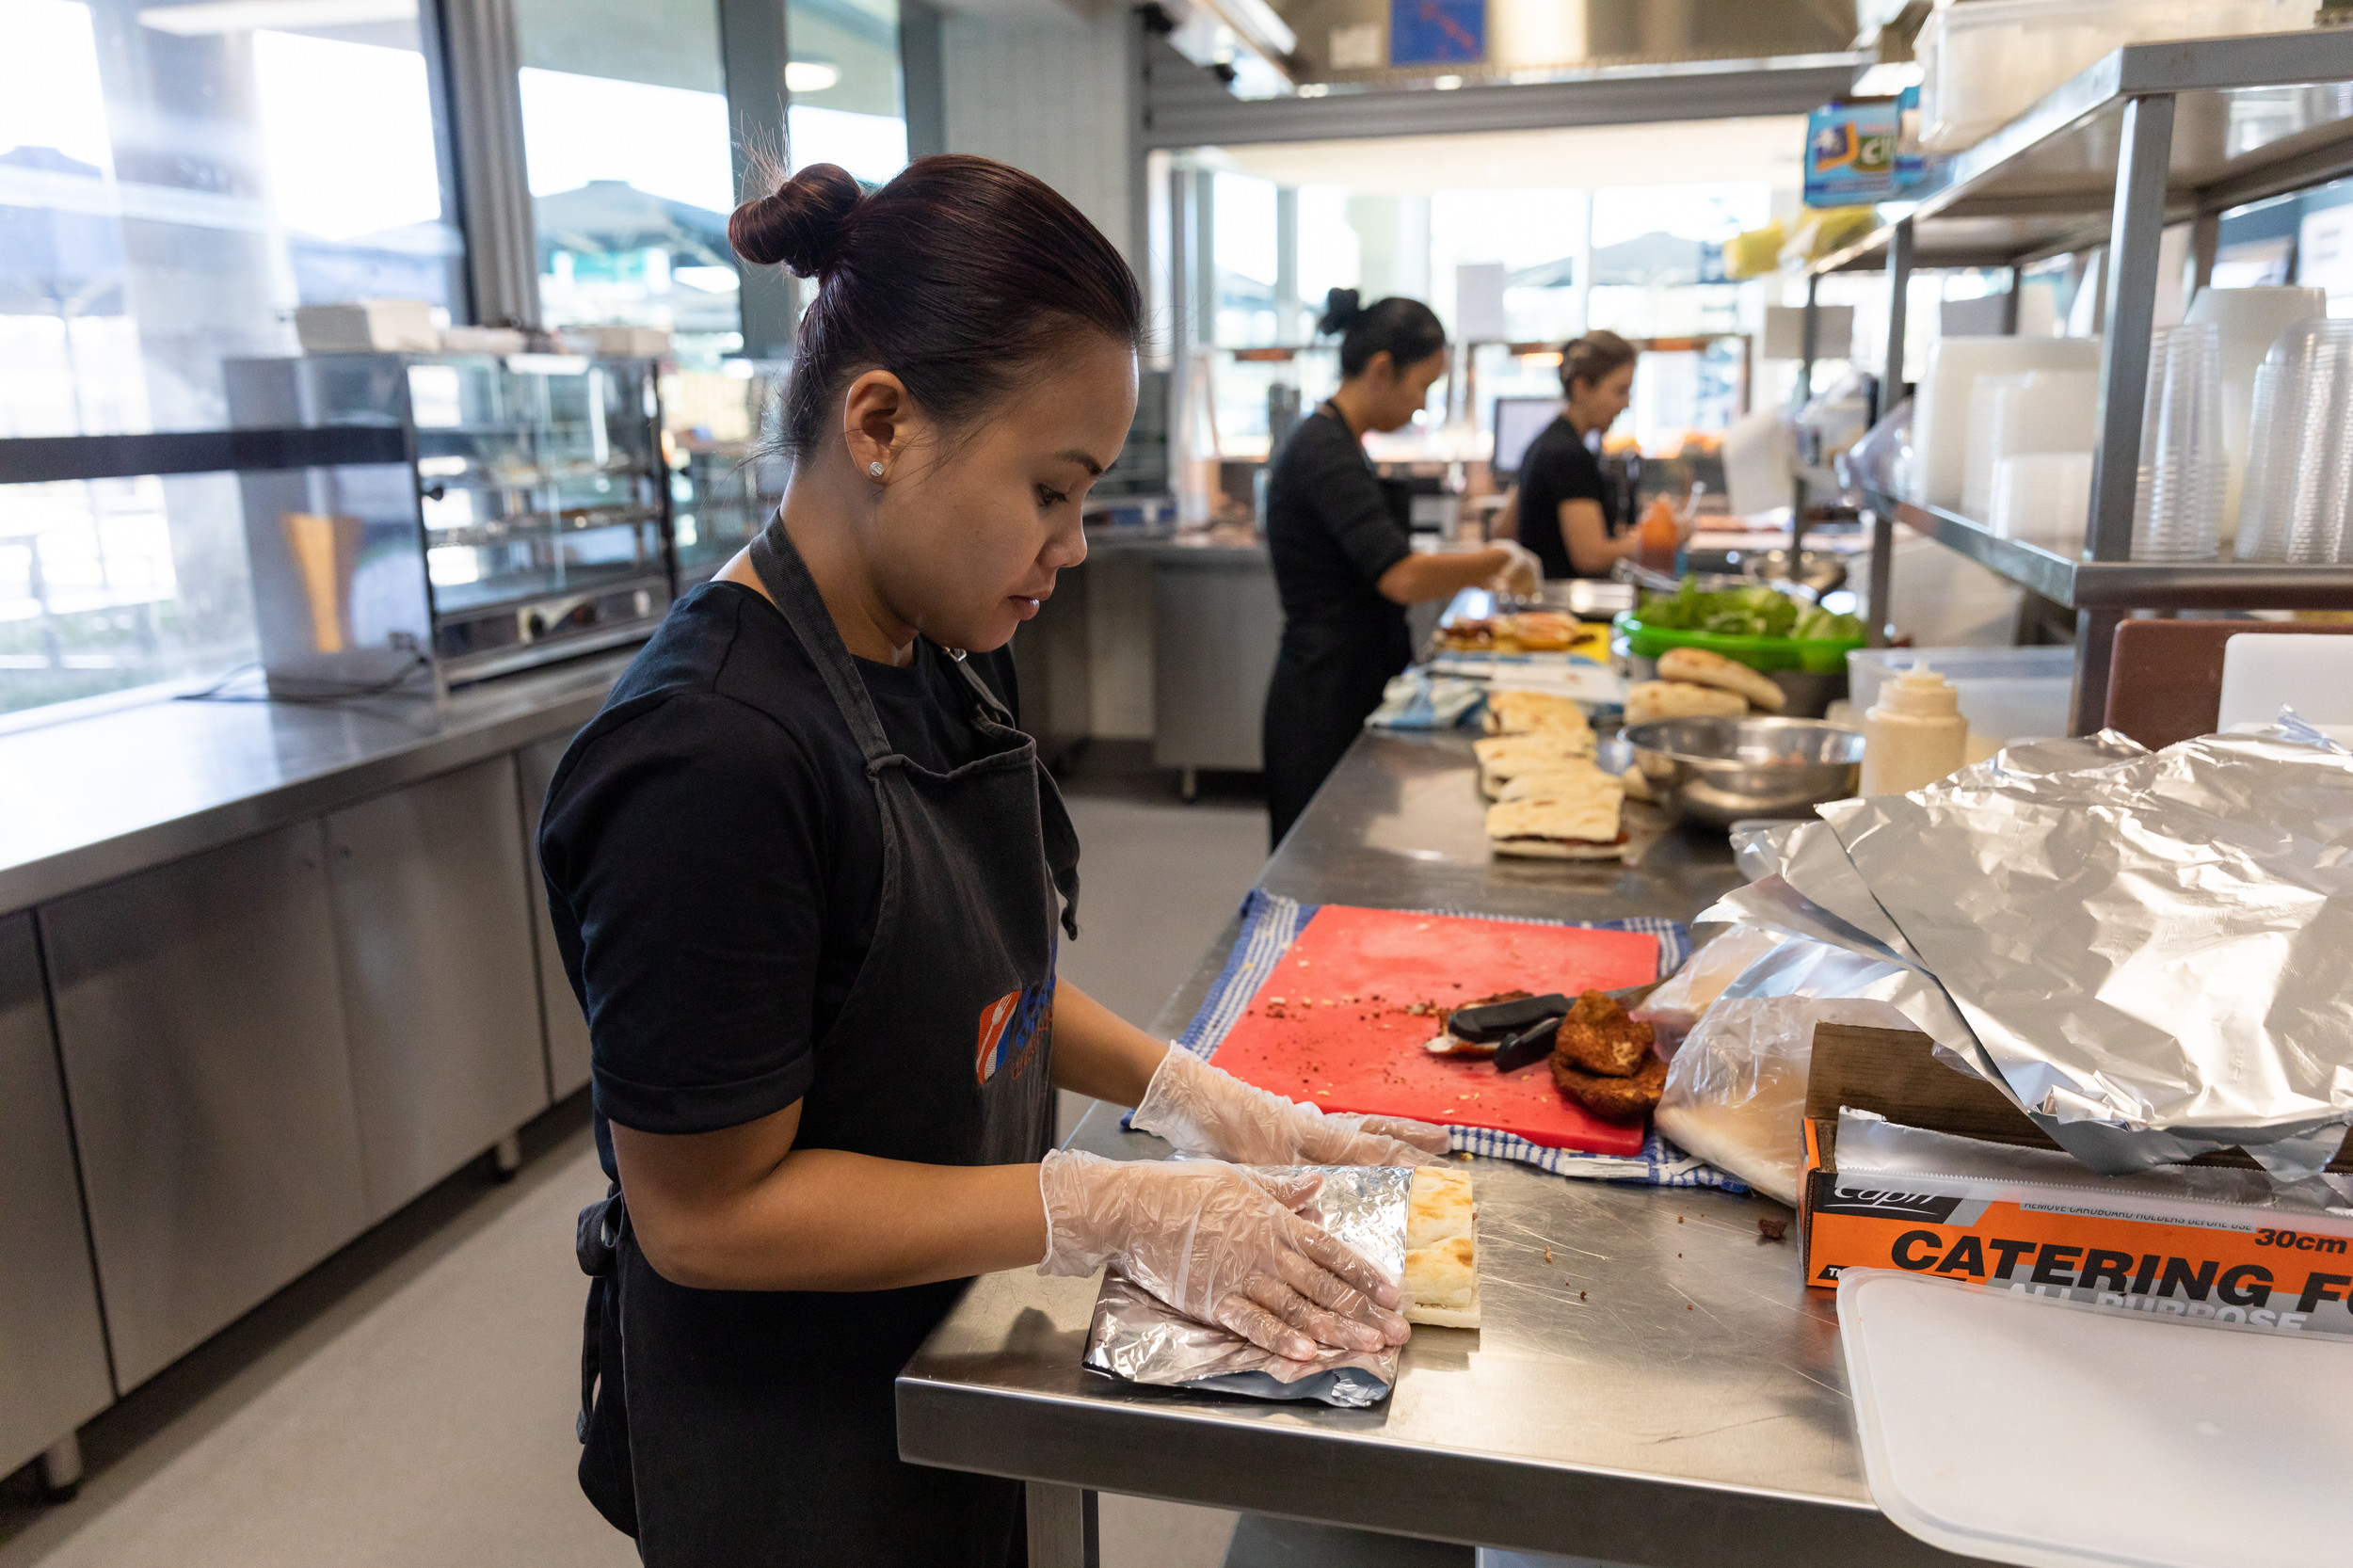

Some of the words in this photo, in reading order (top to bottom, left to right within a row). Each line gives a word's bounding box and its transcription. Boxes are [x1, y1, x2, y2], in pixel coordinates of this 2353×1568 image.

[2254, 1228, 2347, 1254] 30cm
[1891, 1229, 2275, 1307] CATERING
[2296, 1272, 2353, 1315] F
